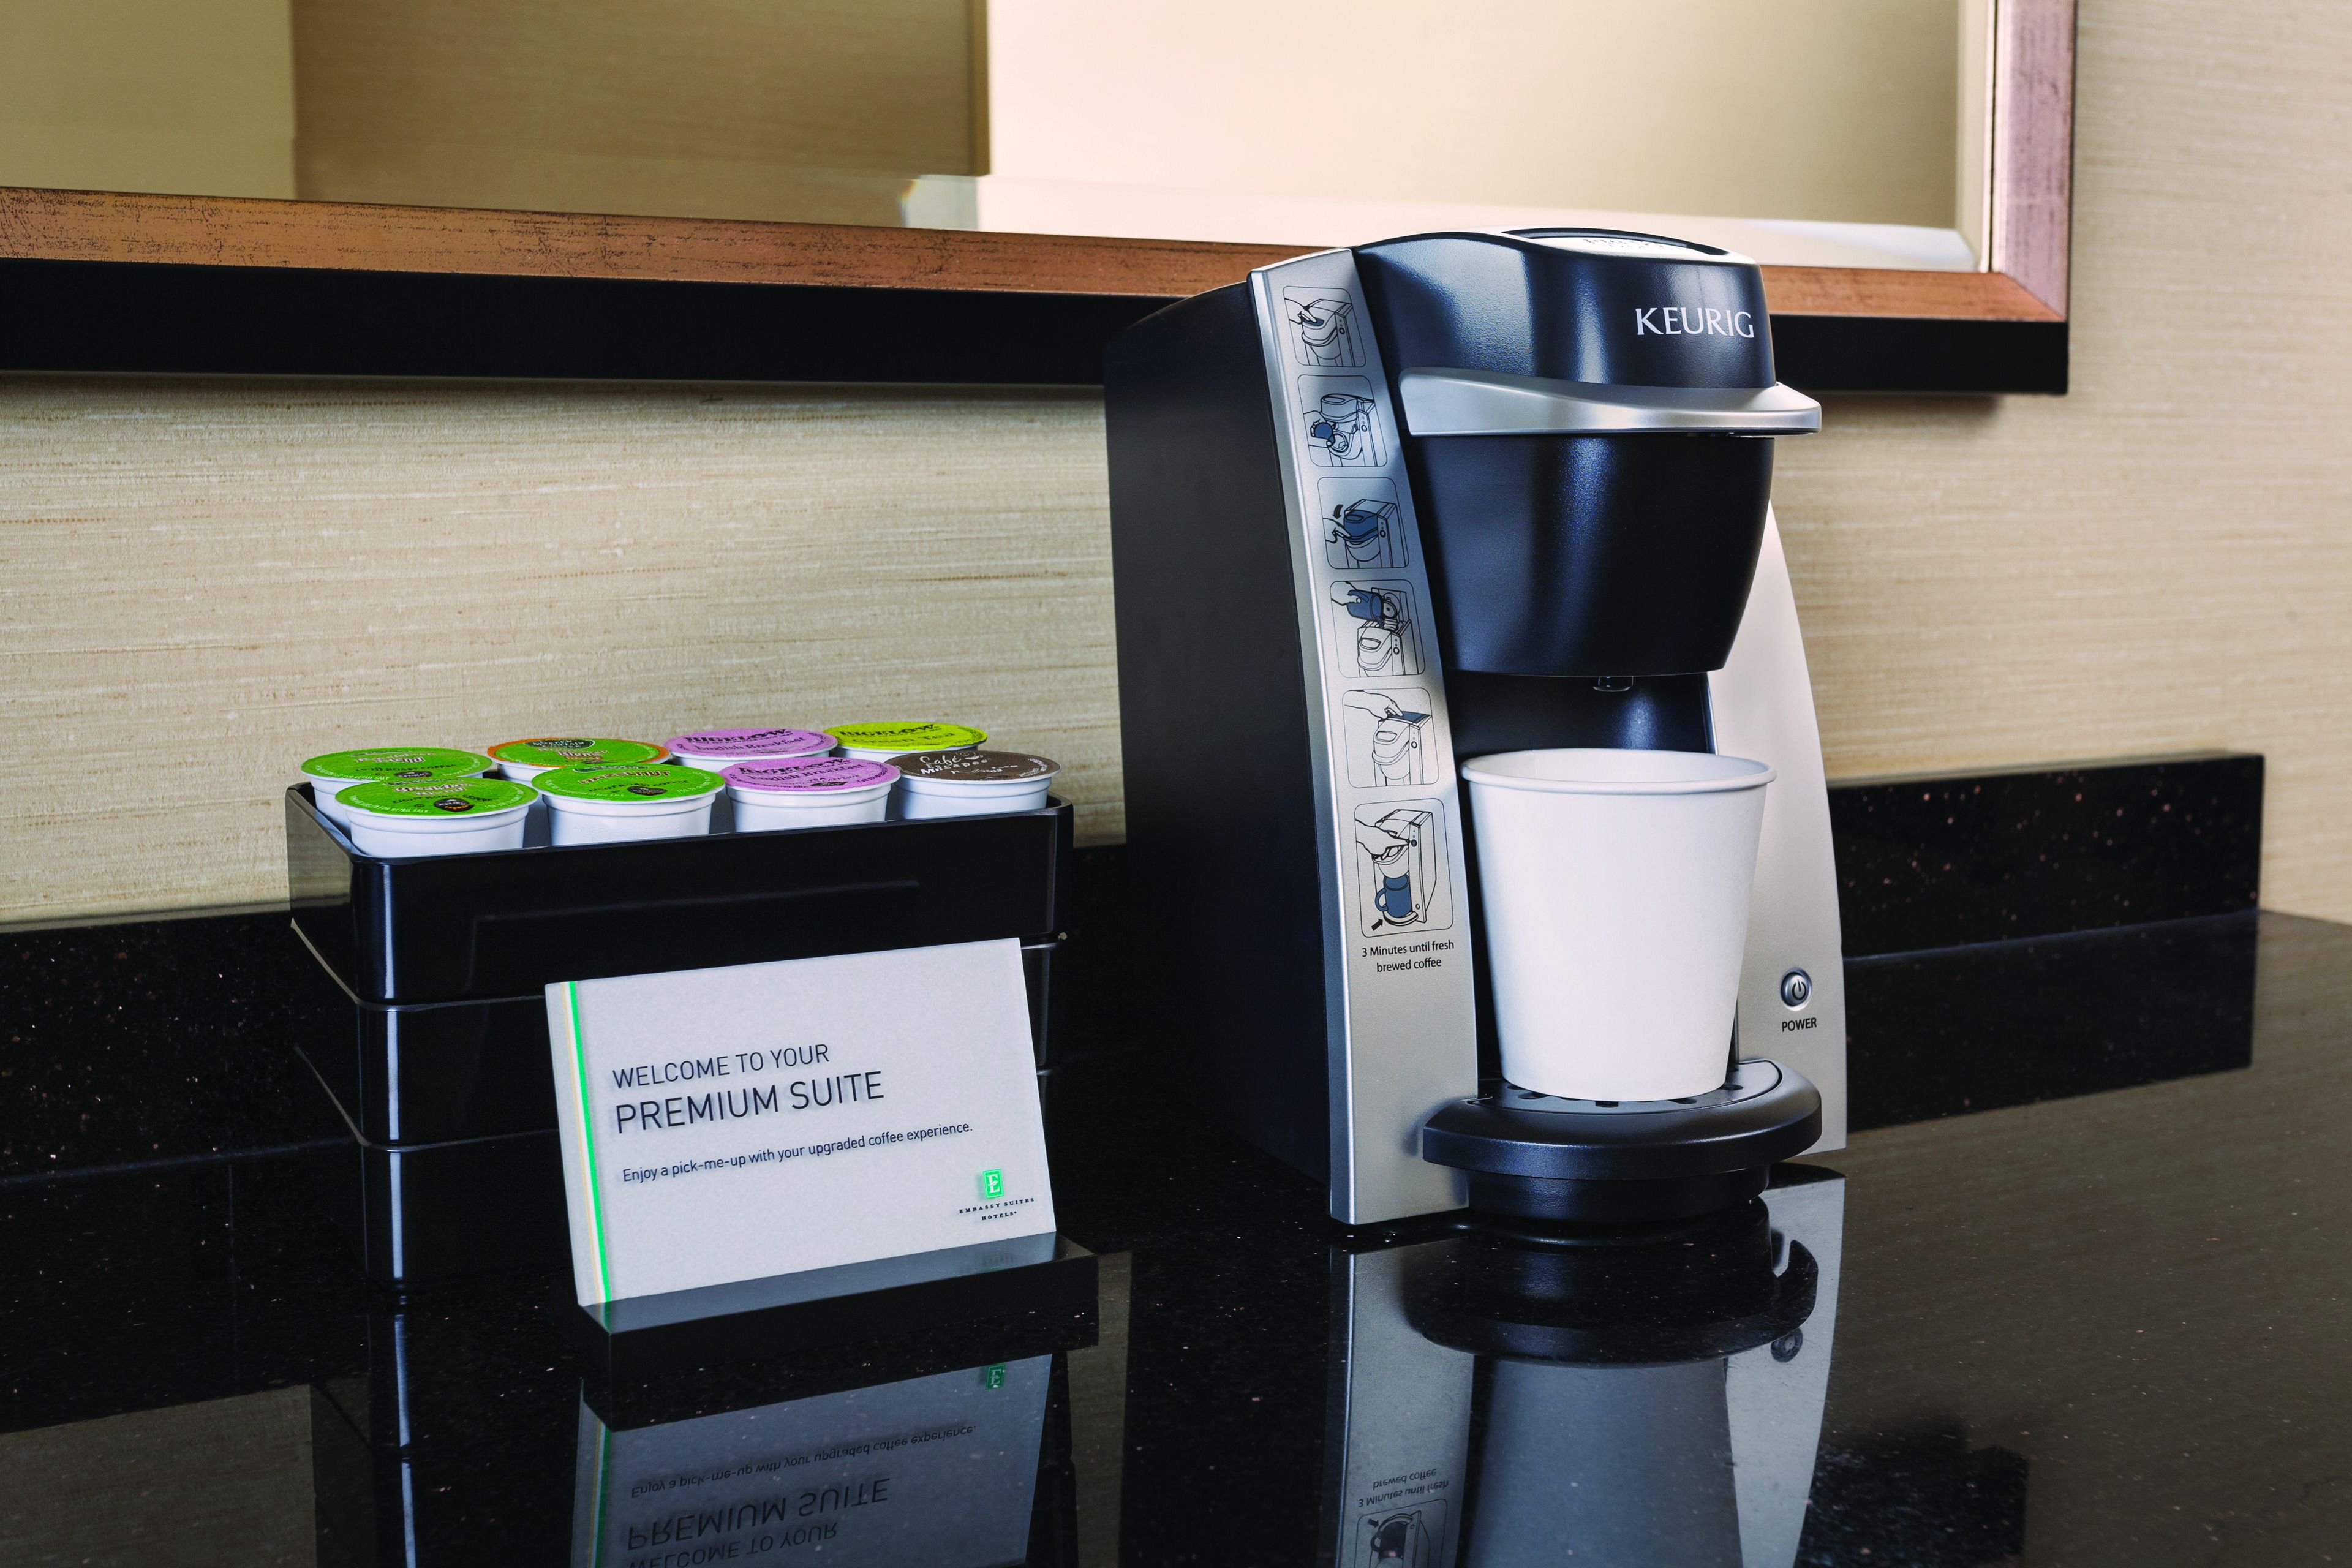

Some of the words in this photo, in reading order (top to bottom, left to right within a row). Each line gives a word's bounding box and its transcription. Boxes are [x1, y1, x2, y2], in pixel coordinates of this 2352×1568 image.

[1635, 307, 1755, 338] KEURIG
[684, 729, 786, 742] BIGELOW
[839, 724, 934, 736] BIGELOW
[745, 737, 805, 749] Breakfast
[739, 759, 845, 774] BIGELOW
[919, 755, 962, 766] Café
[802, 764, 865, 776] Breakfast
[1362, 948, 1368, 957] 3
[1370, 946, 1407, 957] Minutes
[1409, 941, 1430, 952] until
[1432, 940, 1455, 951] fresh
[1376, 959, 1411, 973] brewed
[1414, 957, 1442, 969] coffee
[1782, 1017, 1817, 1032] POWER
[612, 1055, 730, 1089] WELCOME
[736, 1052, 764, 1073] TO
[769, 1044, 829, 1068] YOUR
[615, 1084, 779, 1134] PREMIUM
[789, 1071, 884, 1110] SUITE
[623, 1167, 657, 1183] Enjoy
[661, 1166, 668, 1177] a
[672, 1155, 746, 1178] pick-me-up
[749, 1149, 775, 1163] with
[778, 1145, 805, 1163] your
[809, 1136, 865, 1157] upgraded
[869, 1131, 903, 1147] coffee
[907, 1121, 973, 1142] experience.
[959, 1202, 1001, 1214] EMBASSY
[1004, 1197, 1035, 1207] SUITES
